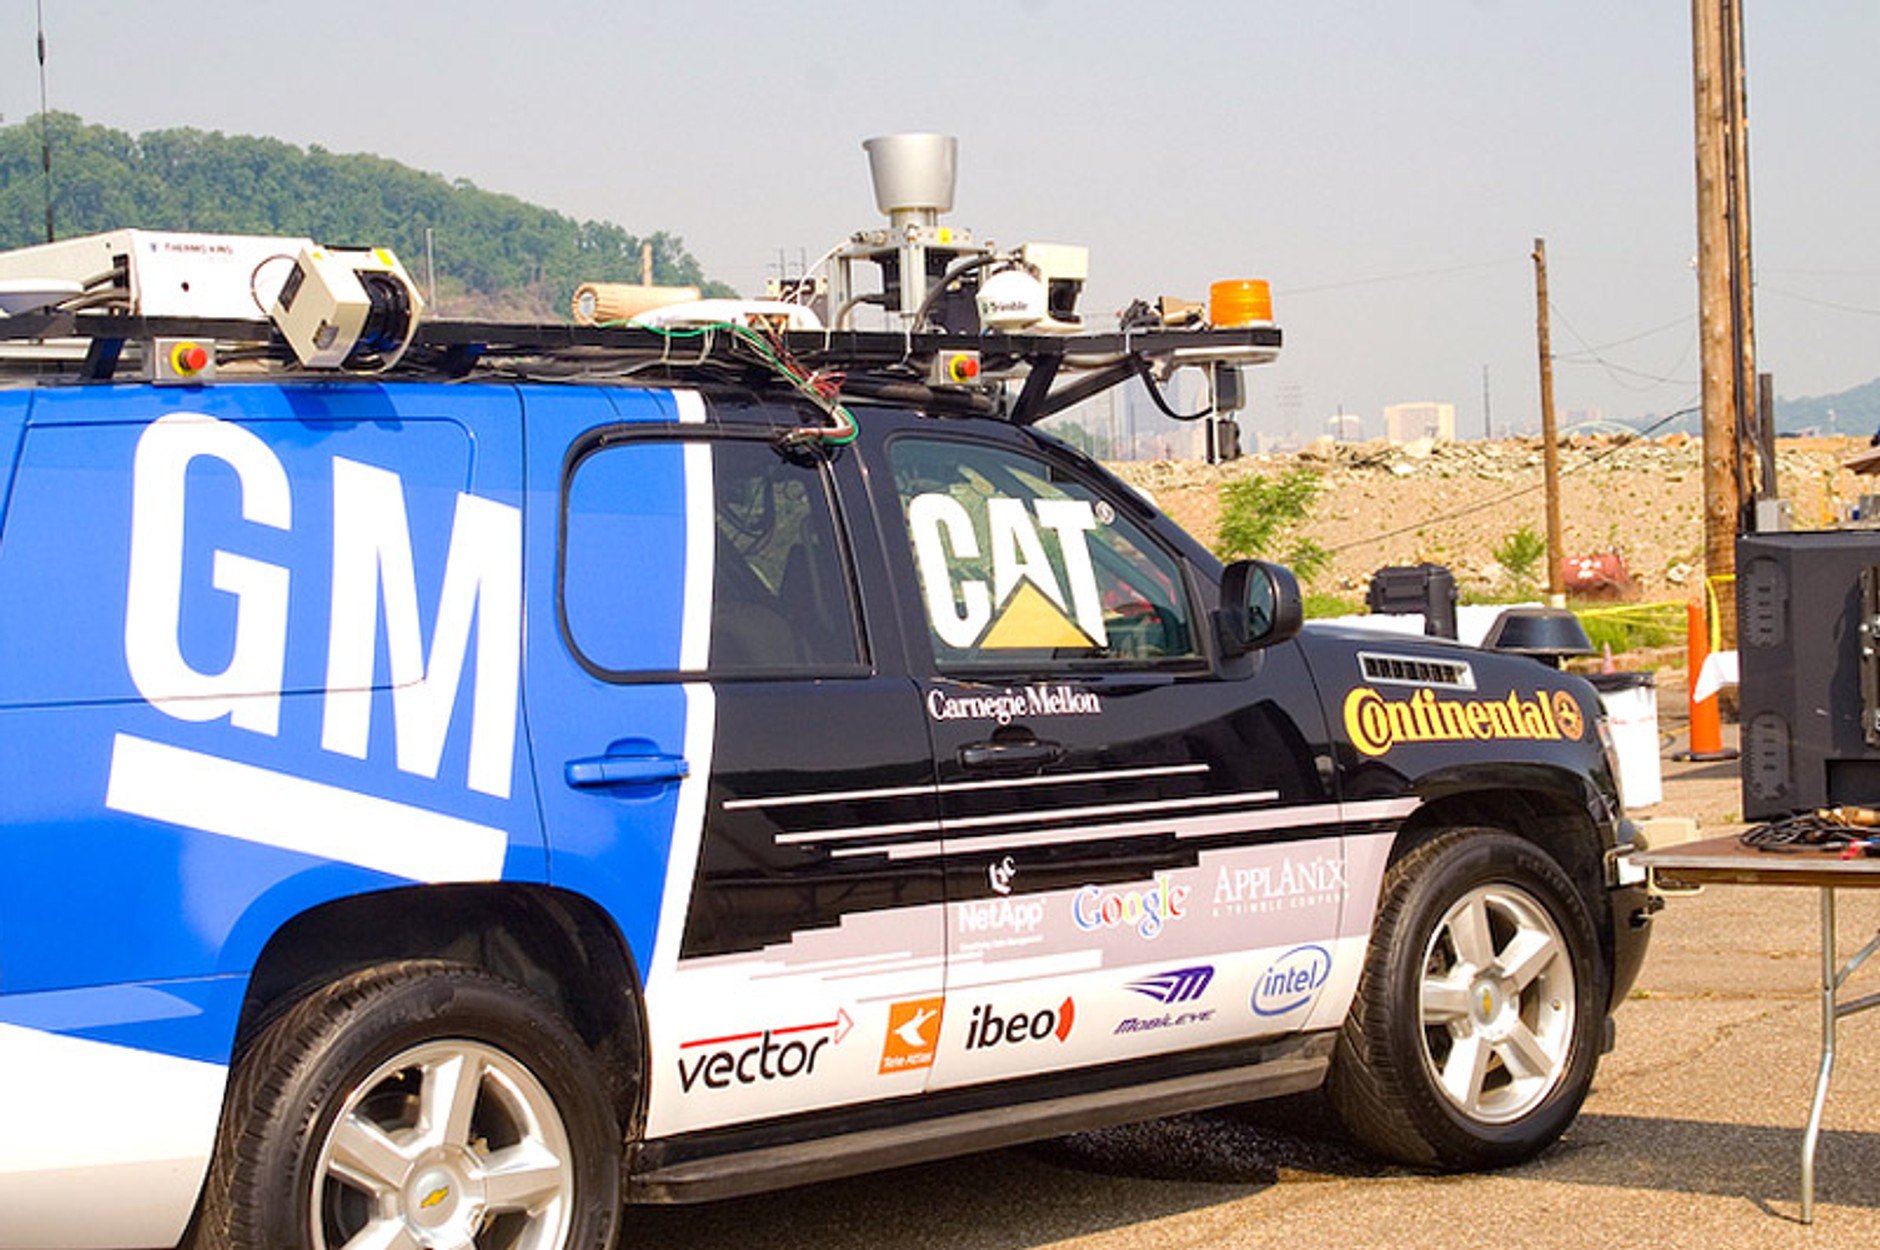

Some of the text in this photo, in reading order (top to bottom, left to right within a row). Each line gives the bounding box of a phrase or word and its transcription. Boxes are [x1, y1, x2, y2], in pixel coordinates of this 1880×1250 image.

[909, 492, 1109, 650] CAT
[124, 411, 523, 800] GM
[927, 685, 1102, 725] Carnegie Mellon
[1342, 686, 1562, 757] Continental
[958, 899, 1044, 934] NetApp
[1073, 873, 1188, 939] Google
[1263, 959, 1319, 998] intel
[965, 1003, 1056, 1051] ibeo
[677, 1029, 830, 1094] vector
